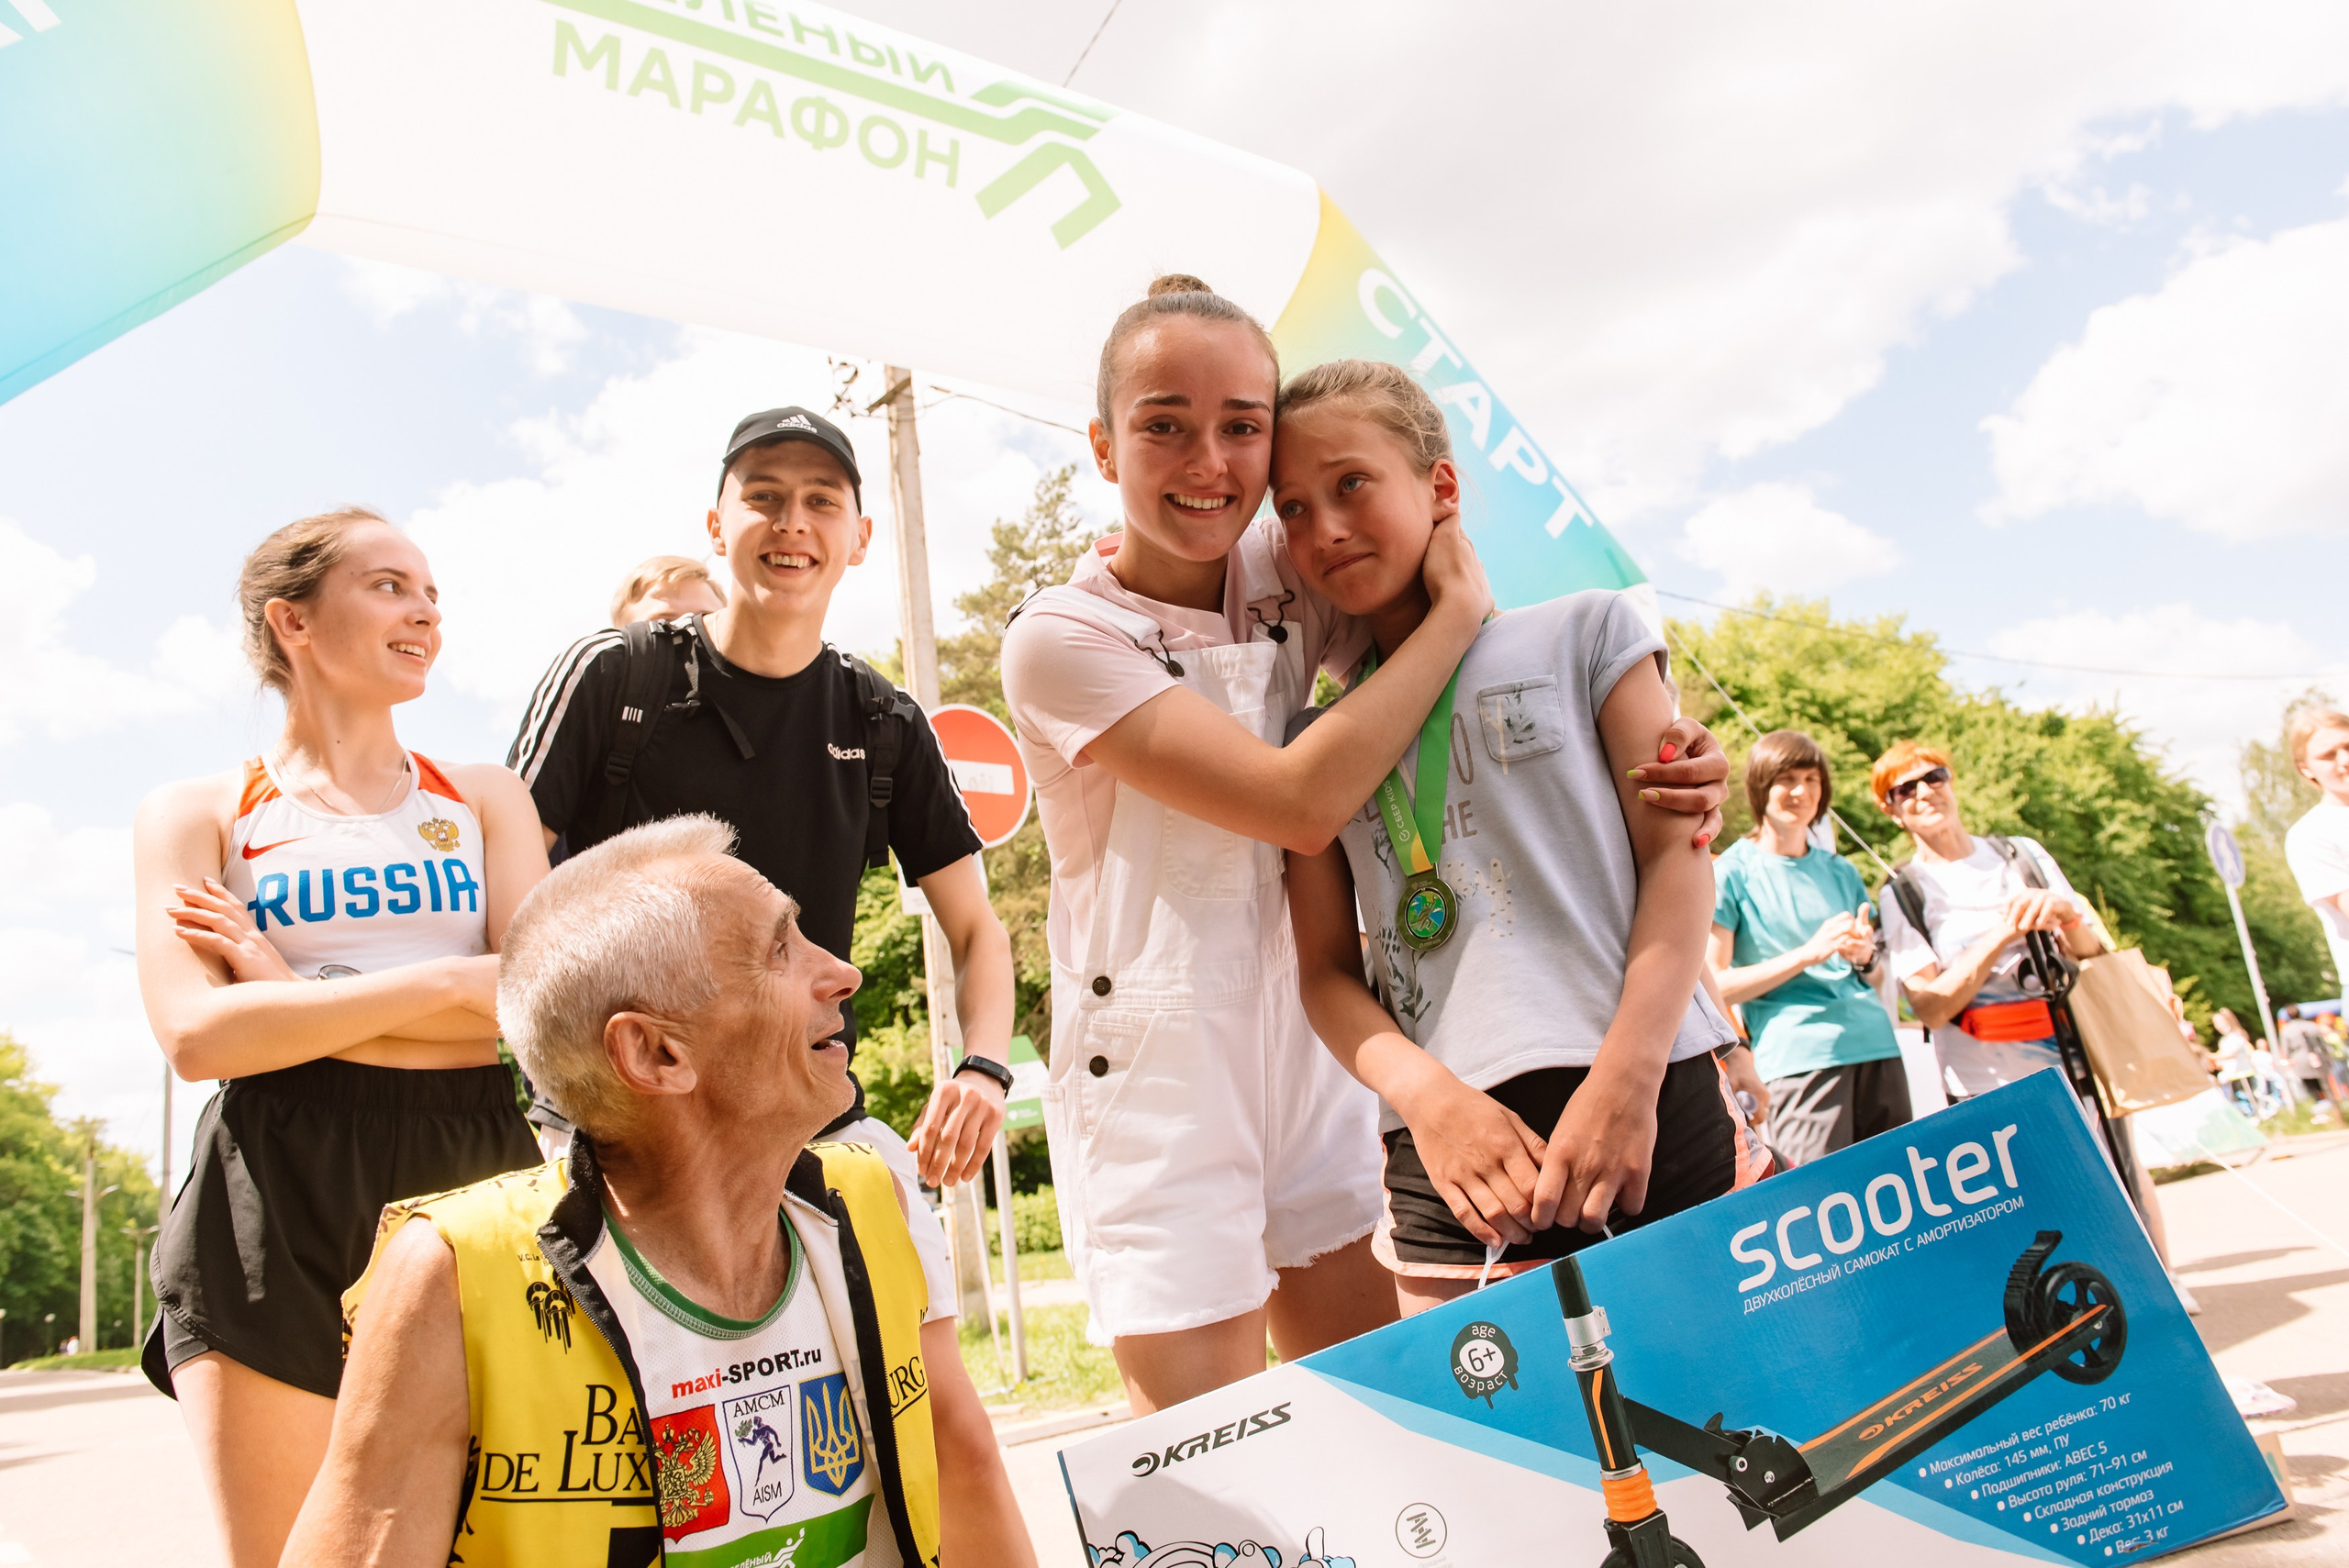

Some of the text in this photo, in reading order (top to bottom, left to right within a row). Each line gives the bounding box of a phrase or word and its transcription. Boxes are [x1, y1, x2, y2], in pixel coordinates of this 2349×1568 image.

[552, 18, 961, 190] МАРАФОН
[776, 422, 818, 434] adidas
[1357, 267, 1595, 540] СТАРТ
[827, 742, 866, 761] adidas
[1382, 780, 1405, 828] СБЕР KIDS
[247, 858, 480, 932] RUSSIA
[1729, 1123, 2020, 1294] scooter
[1743, 1195, 2024, 1316] ДВУХКОЛЁСНЫЙ САМОКАТ С АМОРТИЗАТОРОМ
[1471, 1325, 1497, 1339] age
[671, 1348, 822, 1399] maxi-SPORT.ru
[1453, 1365, 1508, 1394] возраст
[1467, 1347, 1497, 1373] 6+
[1884, 1362, 1984, 1428] KREISS
[1163, 1401, 1292, 1468] KREISS
[1930, 1393, 2132, 1475] Максимальный вес ребёнка: 70 кг
[1955, 1433, 2070, 1486] Колёса: 145 мм, ПУ
[480, 1451, 540, 1494] DE
[751, 1481, 784, 1507] AISM
[1982, 1460, 2062, 1497] Подшипники:
[2098, 1440, 2108, 1454] 5
[2008, 1485, 2054, 1508] Высота
[2055, 1472, 2087, 1495] руля:
[2132, 1450, 2148, 1463] см
[2034, 1462, 2174, 1519] Складная конструкция
[2061, 1489, 2154, 1531] Задний тормоз
[2089, 1521, 2124, 1544] Дека:
[2167, 1500, 2184, 1514] см
[2156, 1526, 2169, 1539] кг
